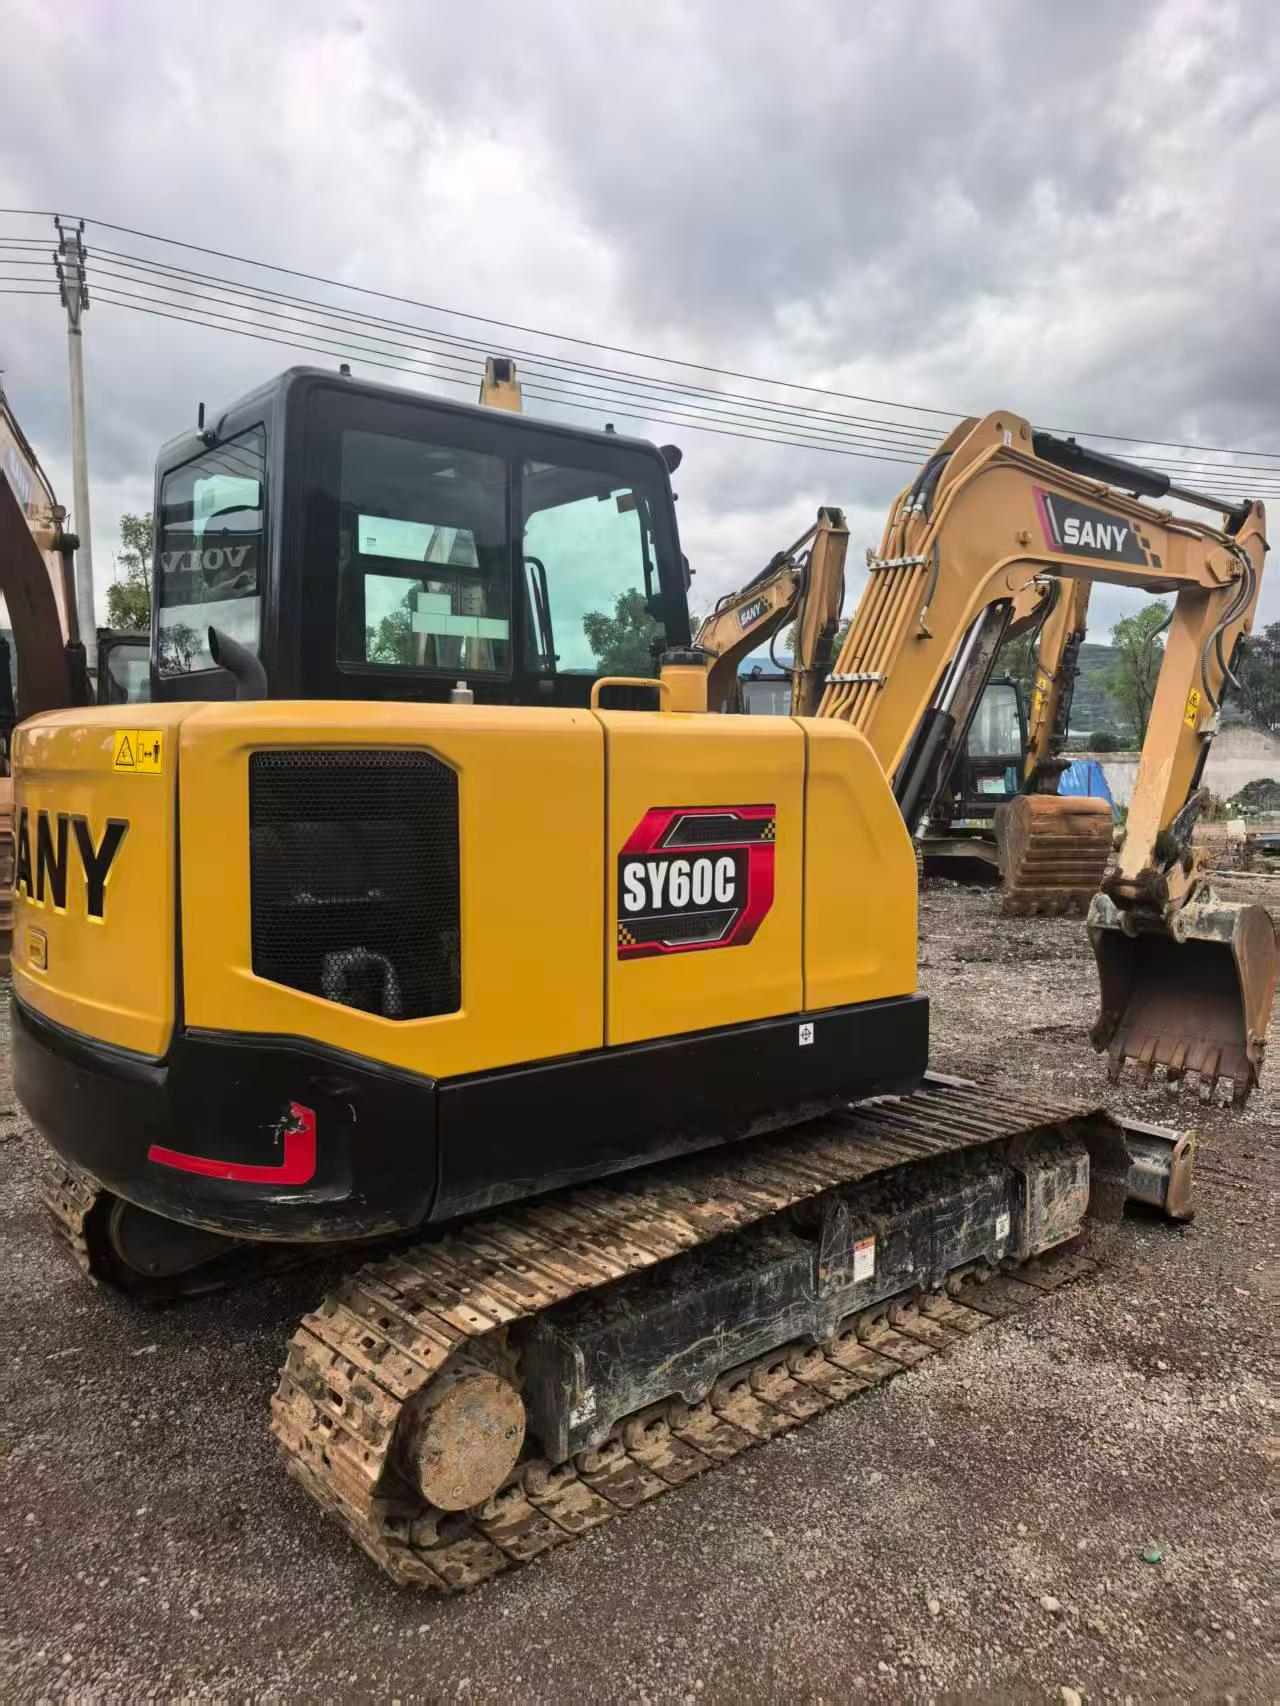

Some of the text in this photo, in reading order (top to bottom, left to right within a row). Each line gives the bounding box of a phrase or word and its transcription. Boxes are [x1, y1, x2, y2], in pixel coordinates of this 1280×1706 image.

[1063, 518, 1128, 552] SANY
[740, 601, 761, 627] SANY
[623, 857, 736, 912] SY60C
